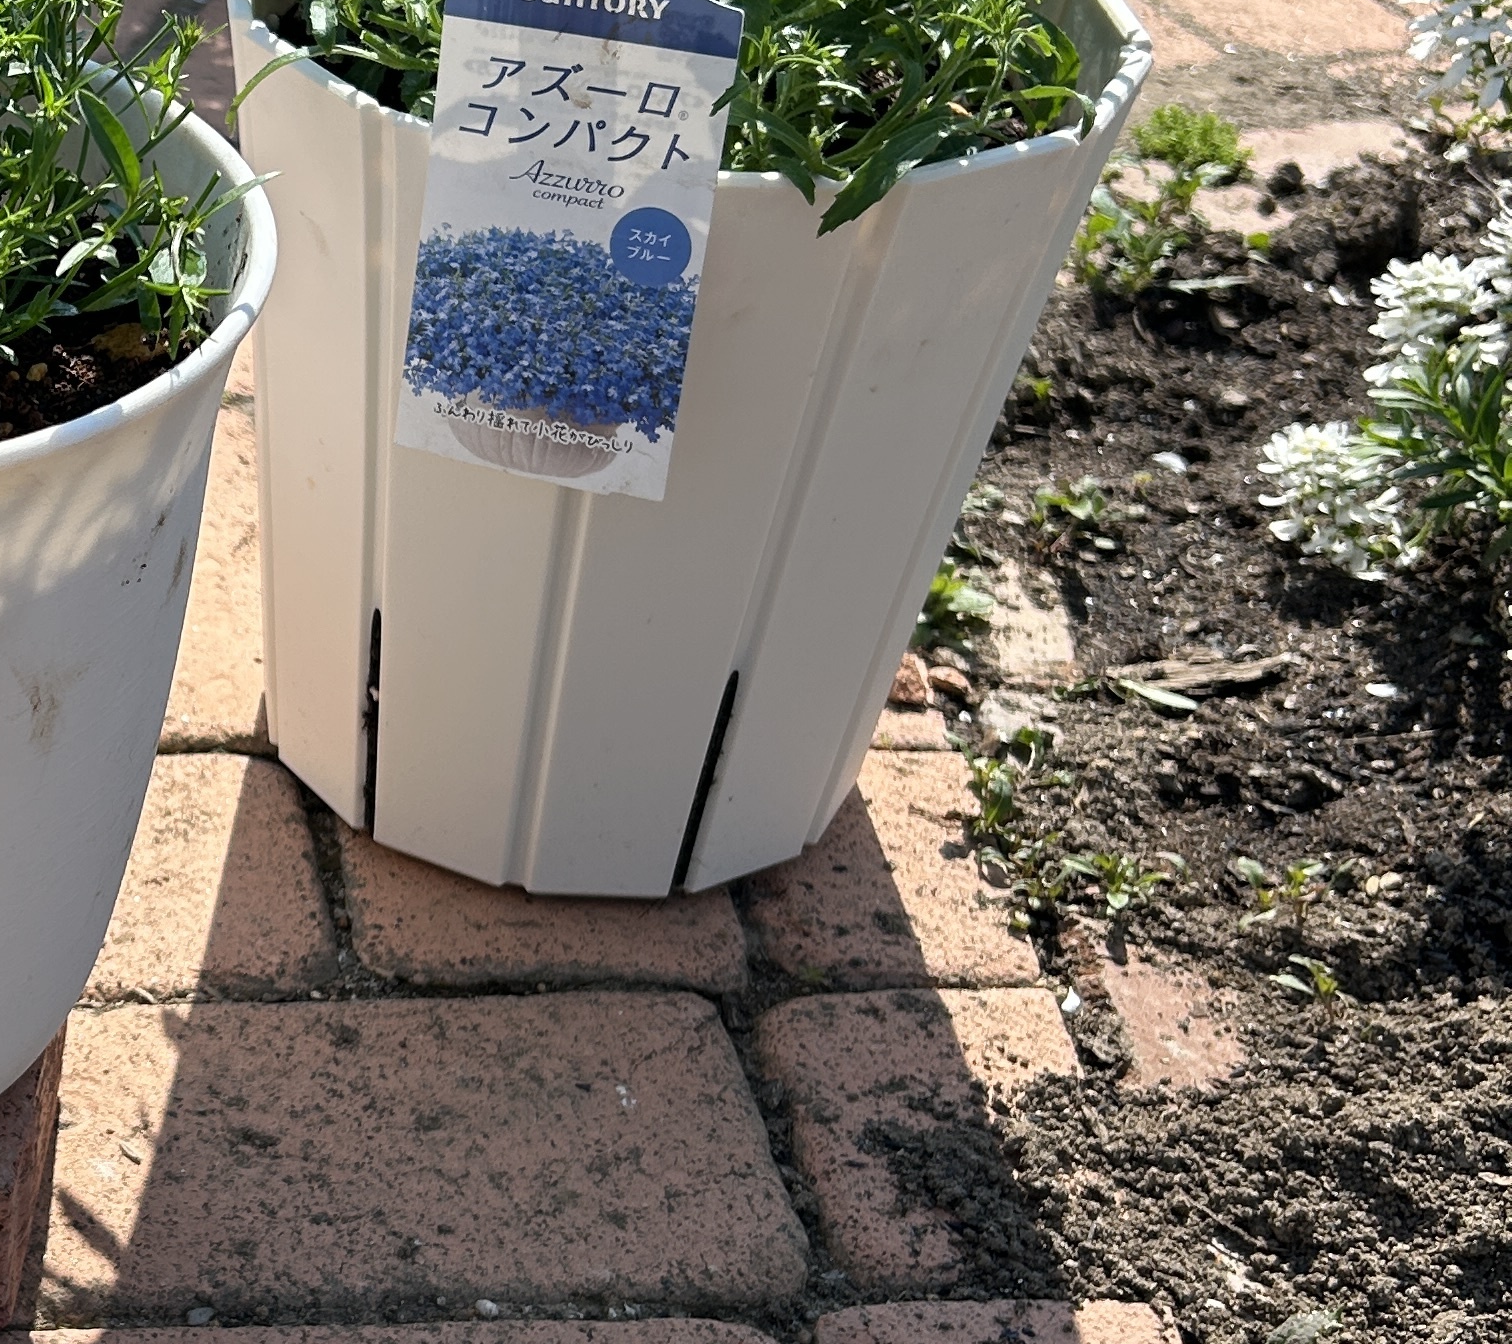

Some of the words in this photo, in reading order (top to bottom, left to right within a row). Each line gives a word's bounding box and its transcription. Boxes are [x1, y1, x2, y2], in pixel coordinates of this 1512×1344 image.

[459, 102, 690, 170] コンパクト
[509, 159, 625, 198] Azzurro
[532, 188, 604, 210] compact
[628, 228, 672, 248] スカイ
[626, 246, 671, 261] ブルー
[433, 402, 634, 453] ふんわり揺れて小花がびっしり
